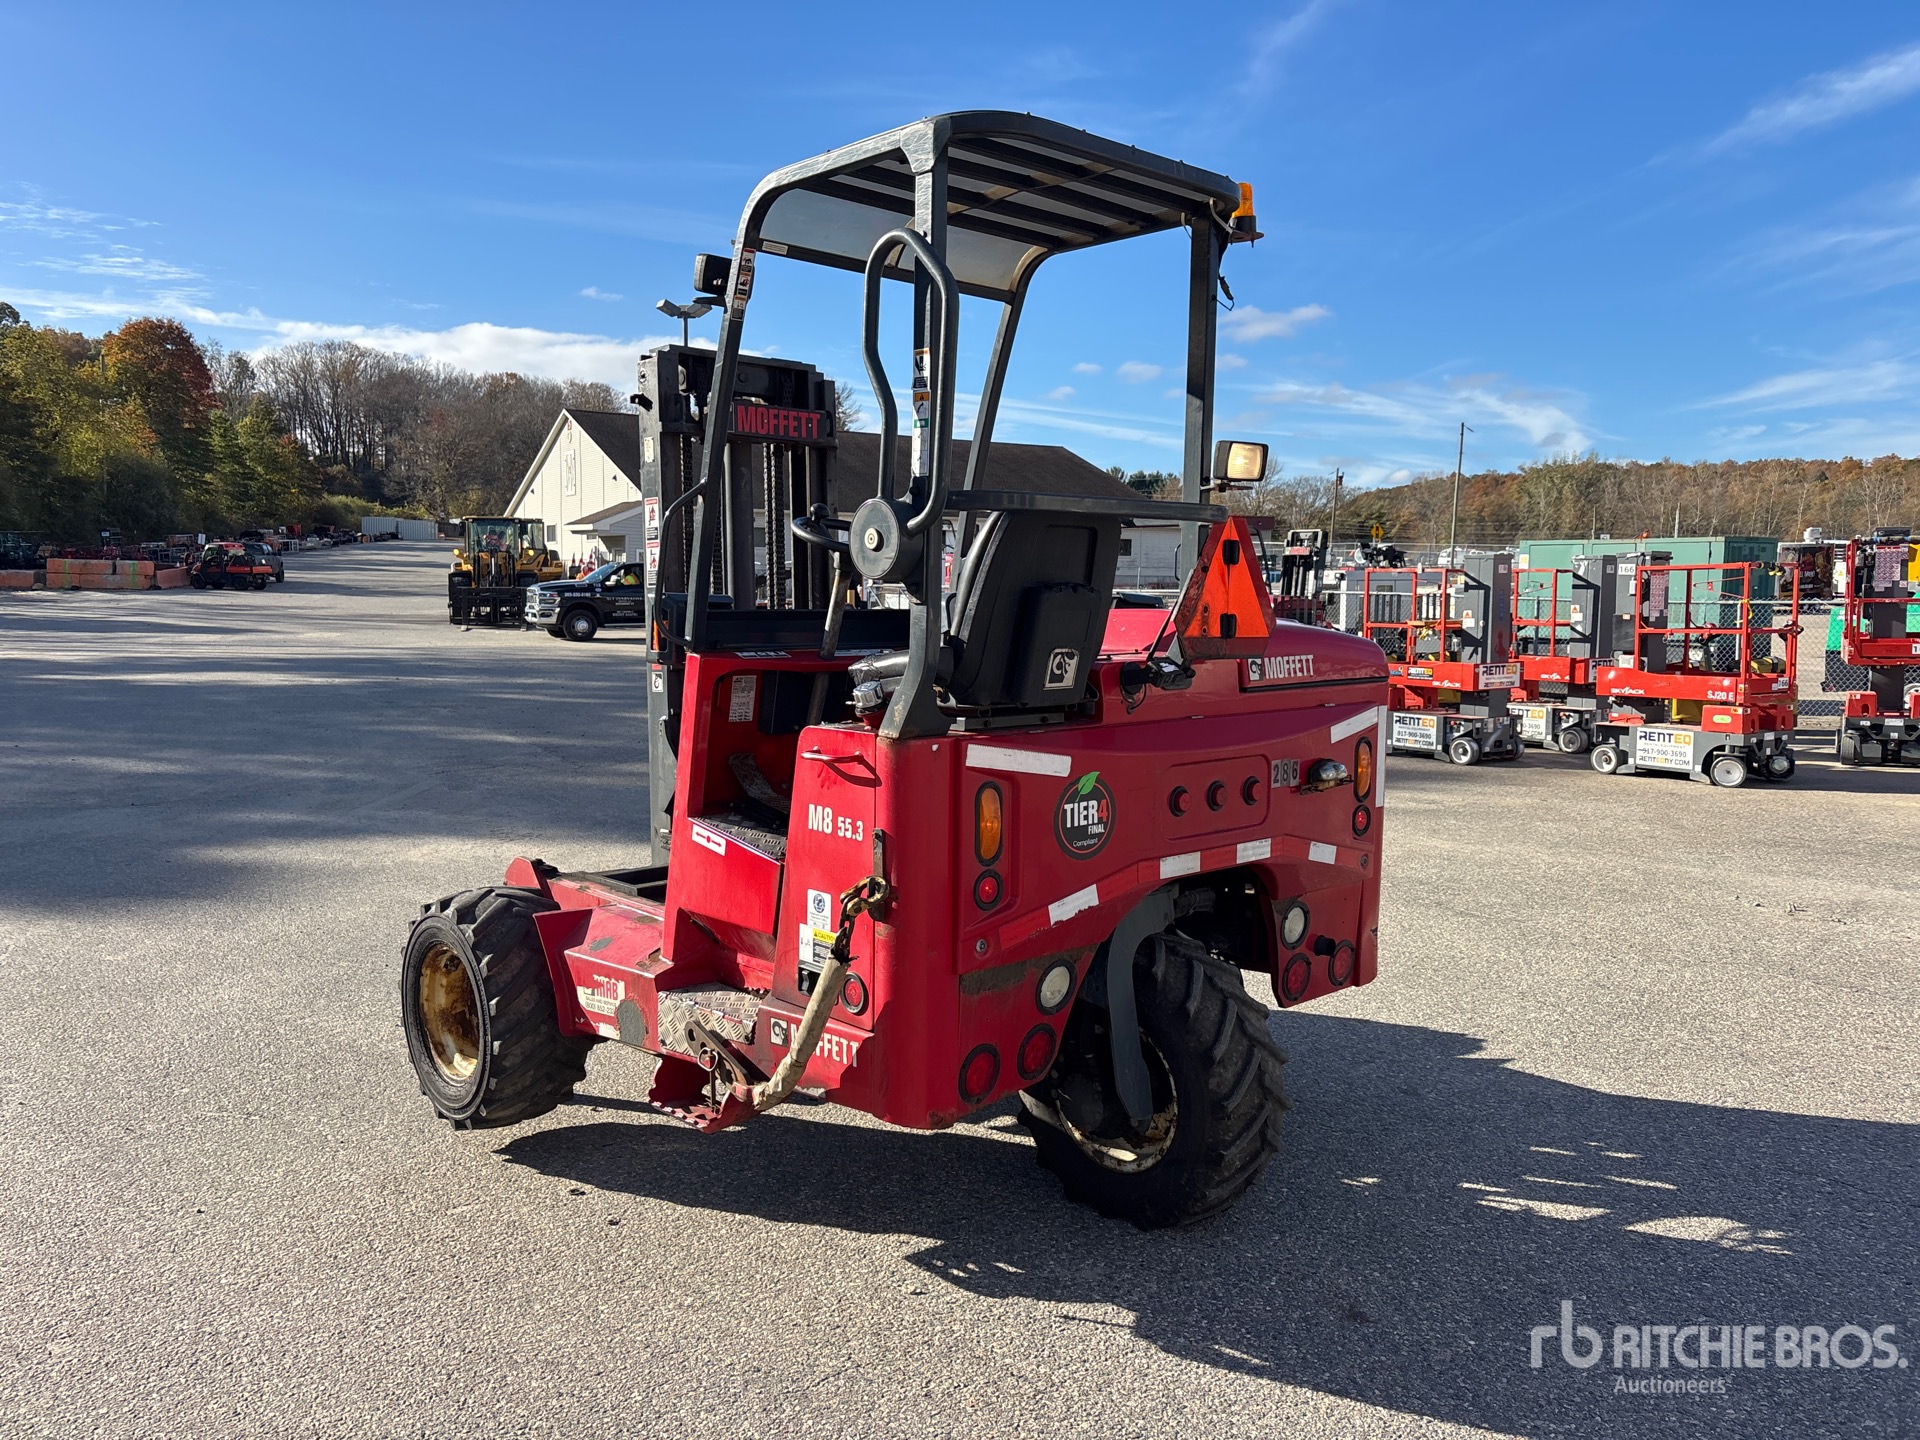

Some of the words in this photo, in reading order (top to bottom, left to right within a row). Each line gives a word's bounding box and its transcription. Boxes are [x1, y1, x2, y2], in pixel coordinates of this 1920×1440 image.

[737, 405, 820, 439] MOFFETT
[1264, 655, 1314, 679] MOFFETT
[1482, 664, 1517, 676] RENTEQ
[1610, 686, 1645, 695] SKYJACK
[1707, 690, 1727, 699] SJ20
[1728, 691, 1735, 700] E
[1510, 707, 1545, 719] ENTEQ
[1394, 715, 1435, 729] RENTEQ
[1639, 730, 1691, 746] RENTEQ
[1272, 762, 1298, 785] 286
[808, 803, 833, 835] M8
[837, 816, 863, 842] 55.3
[1088, 824, 1105, 835] FINAL
[1073, 838, 1099, 847] Compliant
[817, 932, 837, 942] CAUTIO
